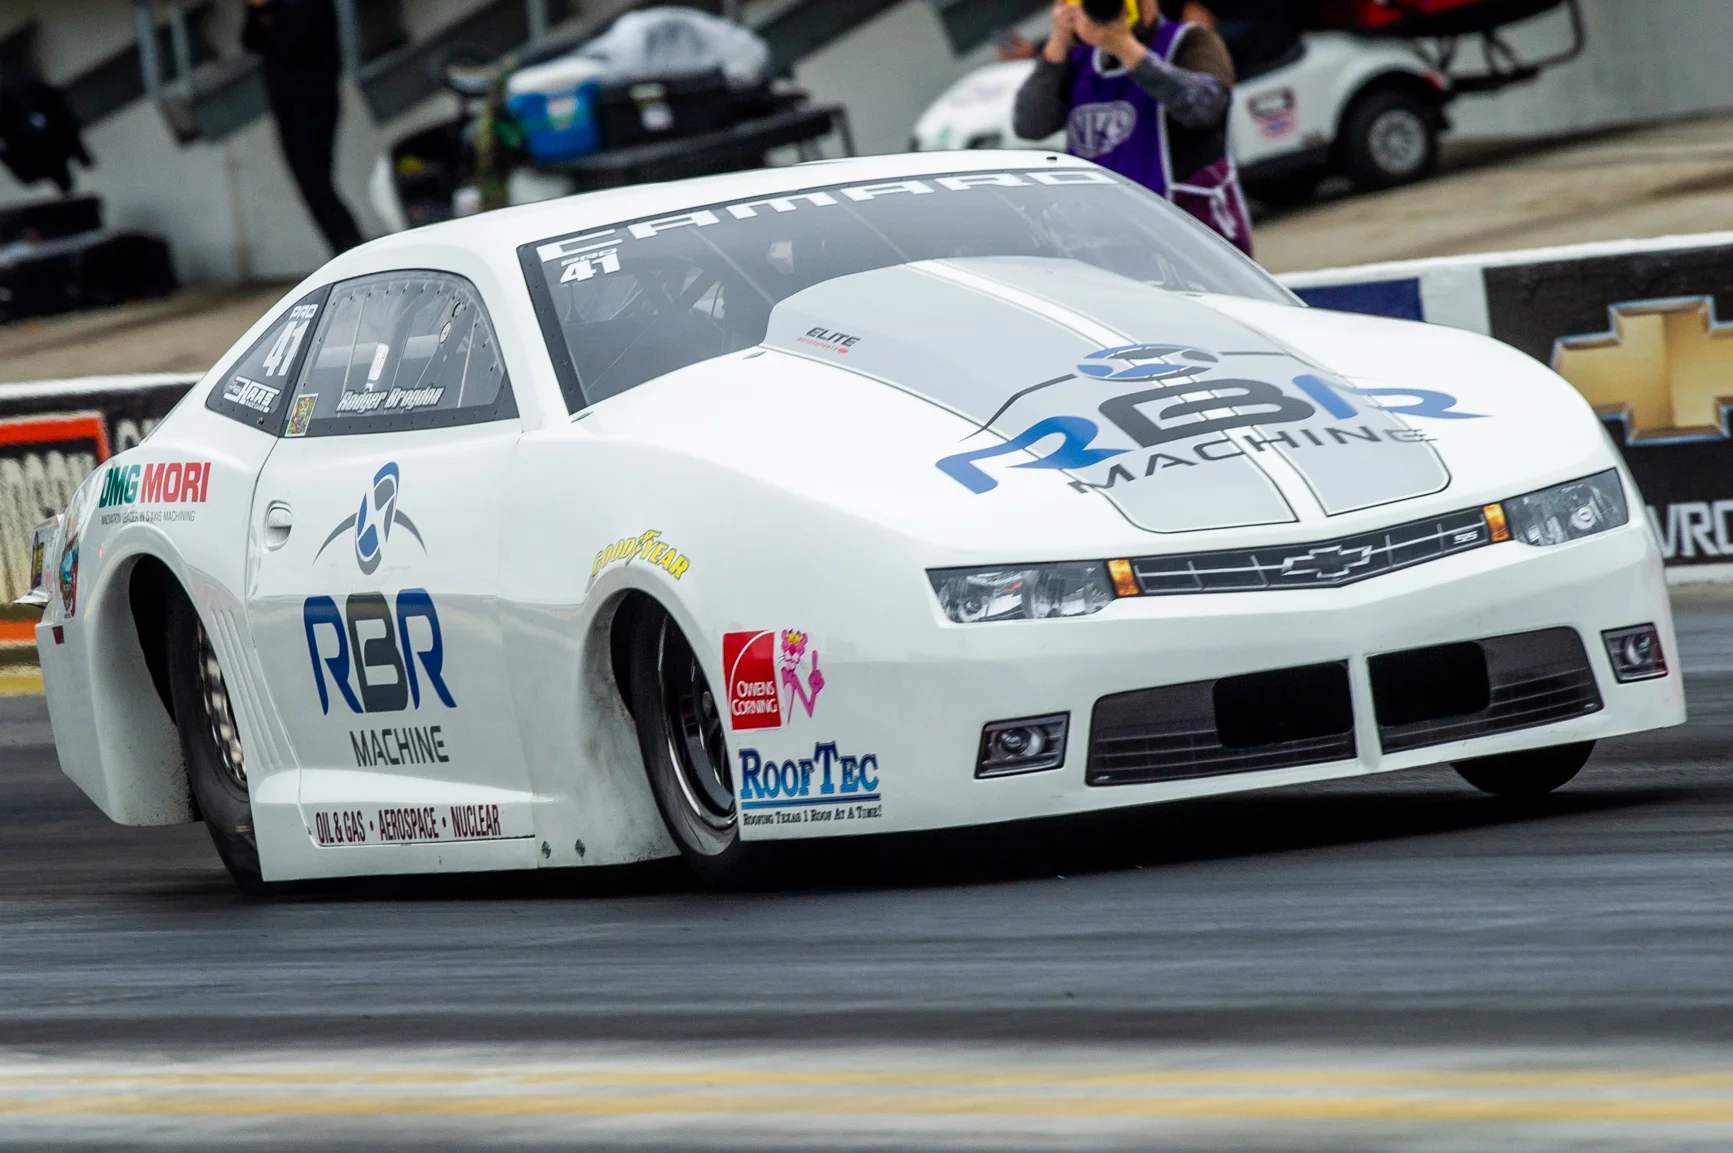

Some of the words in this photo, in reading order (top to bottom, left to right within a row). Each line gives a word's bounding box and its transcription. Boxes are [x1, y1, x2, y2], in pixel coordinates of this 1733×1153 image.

[536, 171, 1119, 262] CAMARO
[560, 252, 620, 284] 41
[288, 304, 319, 321] PRO
[262, 320, 311, 377] 41
[806, 327, 861, 347] ELITE
[336, 389, 388, 414] Rodger
[383, 383, 445, 411] Brogdon
[936, 374, 1494, 494] RBR
[1067, 426, 1438, 494] MACHINE
[98, 464, 141, 508] DMG
[140, 462, 211, 503] MORI
[163, 510, 196, 522] MACHINING
[592, 529, 690, 580] GOODYEAR
[1453, 530, 1478, 544] SS
[303, 588, 457, 716] RBR
[737, 680, 776, 698] OWENS
[731, 698, 778, 716] CORNING
[349, 725, 450, 767] MACHINE
[343, 810, 366, 842] GAS
[378, 807, 440, 841] AEROSPACE
[450, 804, 502, 838] NUCLEAR
[743, 812, 774, 826] ROOFING
[775, 811, 802, 824] TEXAS
[803, 809, 810, 822] 1
[811, 809, 832, 822] ROOF
[834, 808, 846, 820] AT
[847, 807, 854, 819] A
